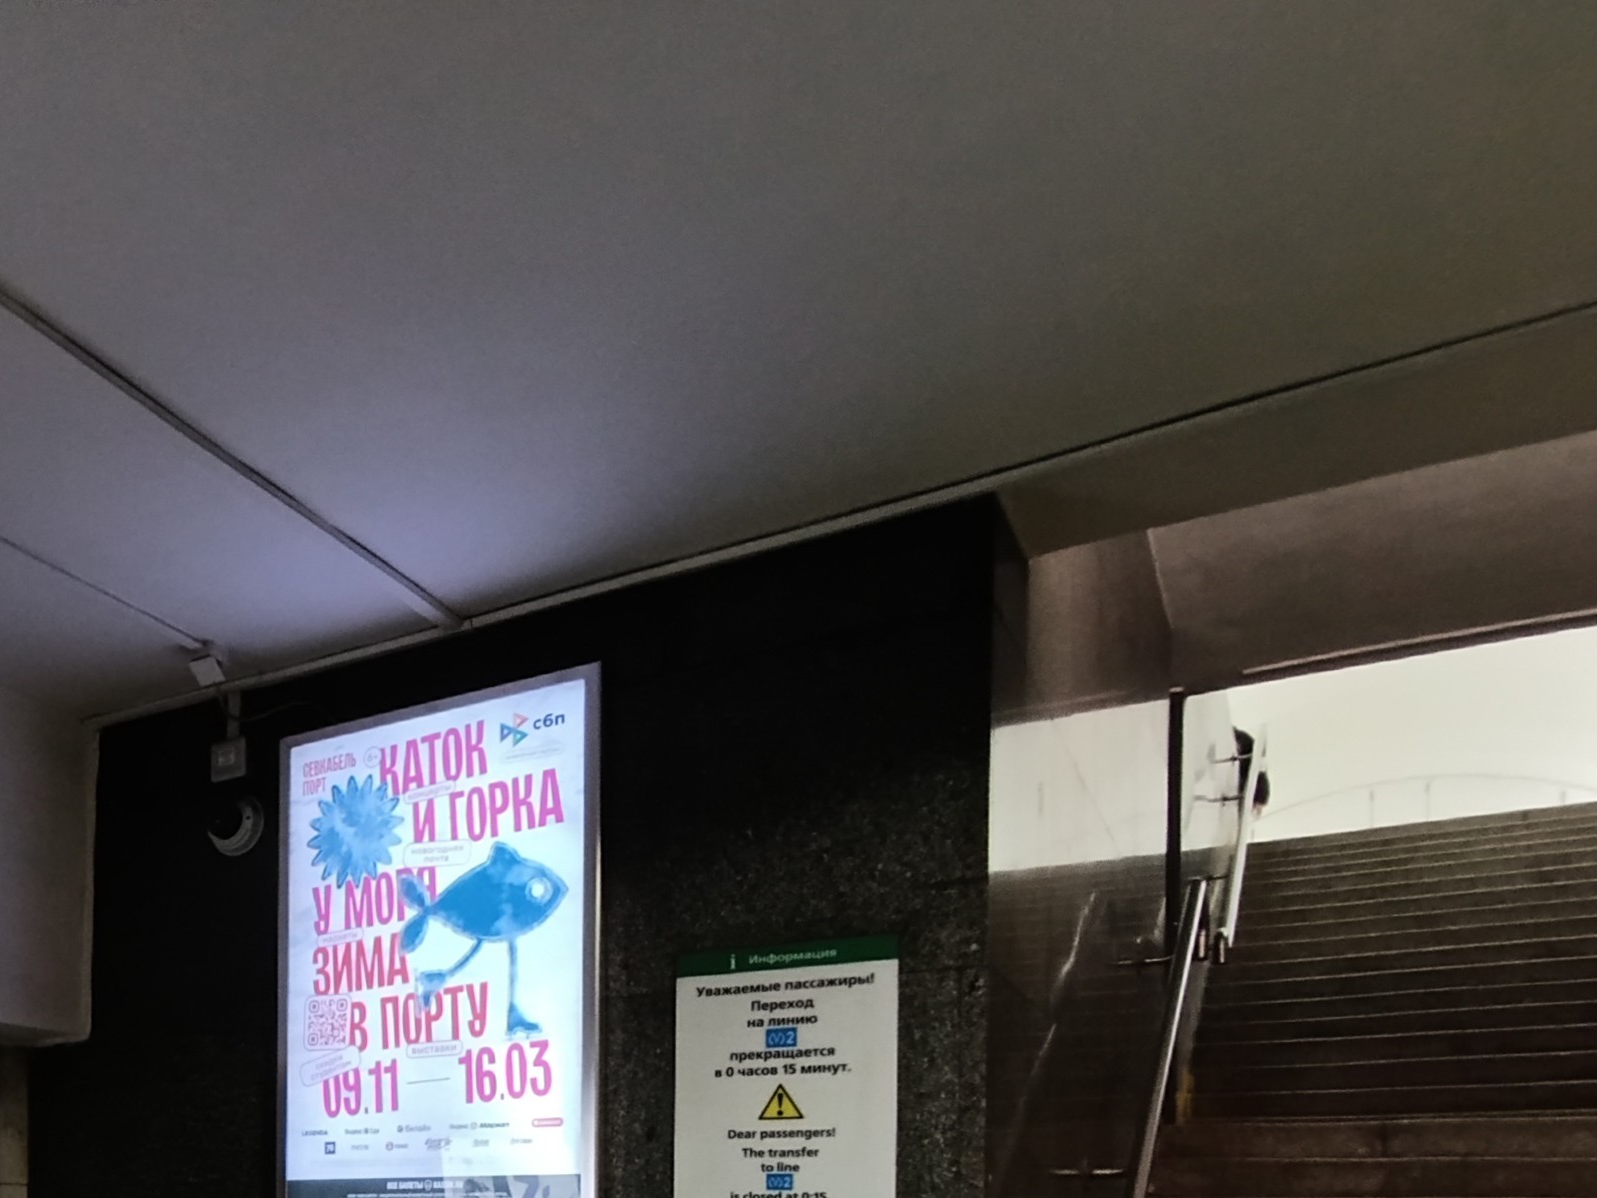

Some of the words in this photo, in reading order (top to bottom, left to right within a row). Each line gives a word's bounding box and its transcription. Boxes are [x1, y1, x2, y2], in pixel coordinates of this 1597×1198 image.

[533, 713, 565, 730] сбп
[303, 753, 356, 778] СЕВКАБЕЛЬ
[380, 719, 487, 796] КАТОК
[303, 777, 327, 796] ПОРТ
[413, 798, 436, 843] И
[450, 768, 564, 842] ГОРКА
[312, 884, 331, 935] У
[313, 932, 410, 996] ЗИМА
[749, 949, 837, 965] Информация
[696, 981, 781, 997] Уважаемые
[785, 973, 875, 991] пассажиры!
[751, 998, 815, 1013] Переход
[350, 1001, 368, 1053] В
[380, 981, 488, 1050] ПОРТУ
[747, 1018, 764, 1028] на
[767, 1014, 818, 1027] линию
[729, 1047, 836, 1063] прекращается
[458, 1039, 552, 1104] 16.03
[714, 1069, 722, 1078] в
[725, 1066, 734, 1077] 0
[737, 1066, 778, 1077] часов
[782, 1064, 797, 1075] 15
[800, 1063, 852, 1075] минут.
[323, 1058, 399, 1118] 09.11
[728, 1130, 757, 1139] Dear
[760, 1128, 836, 1140] passengers!
[742, 1147, 765, 1158] The
[768, 1147, 819, 1158] transfer
[761, 1163, 774, 1172] to
[777, 1162, 800, 1172] line
